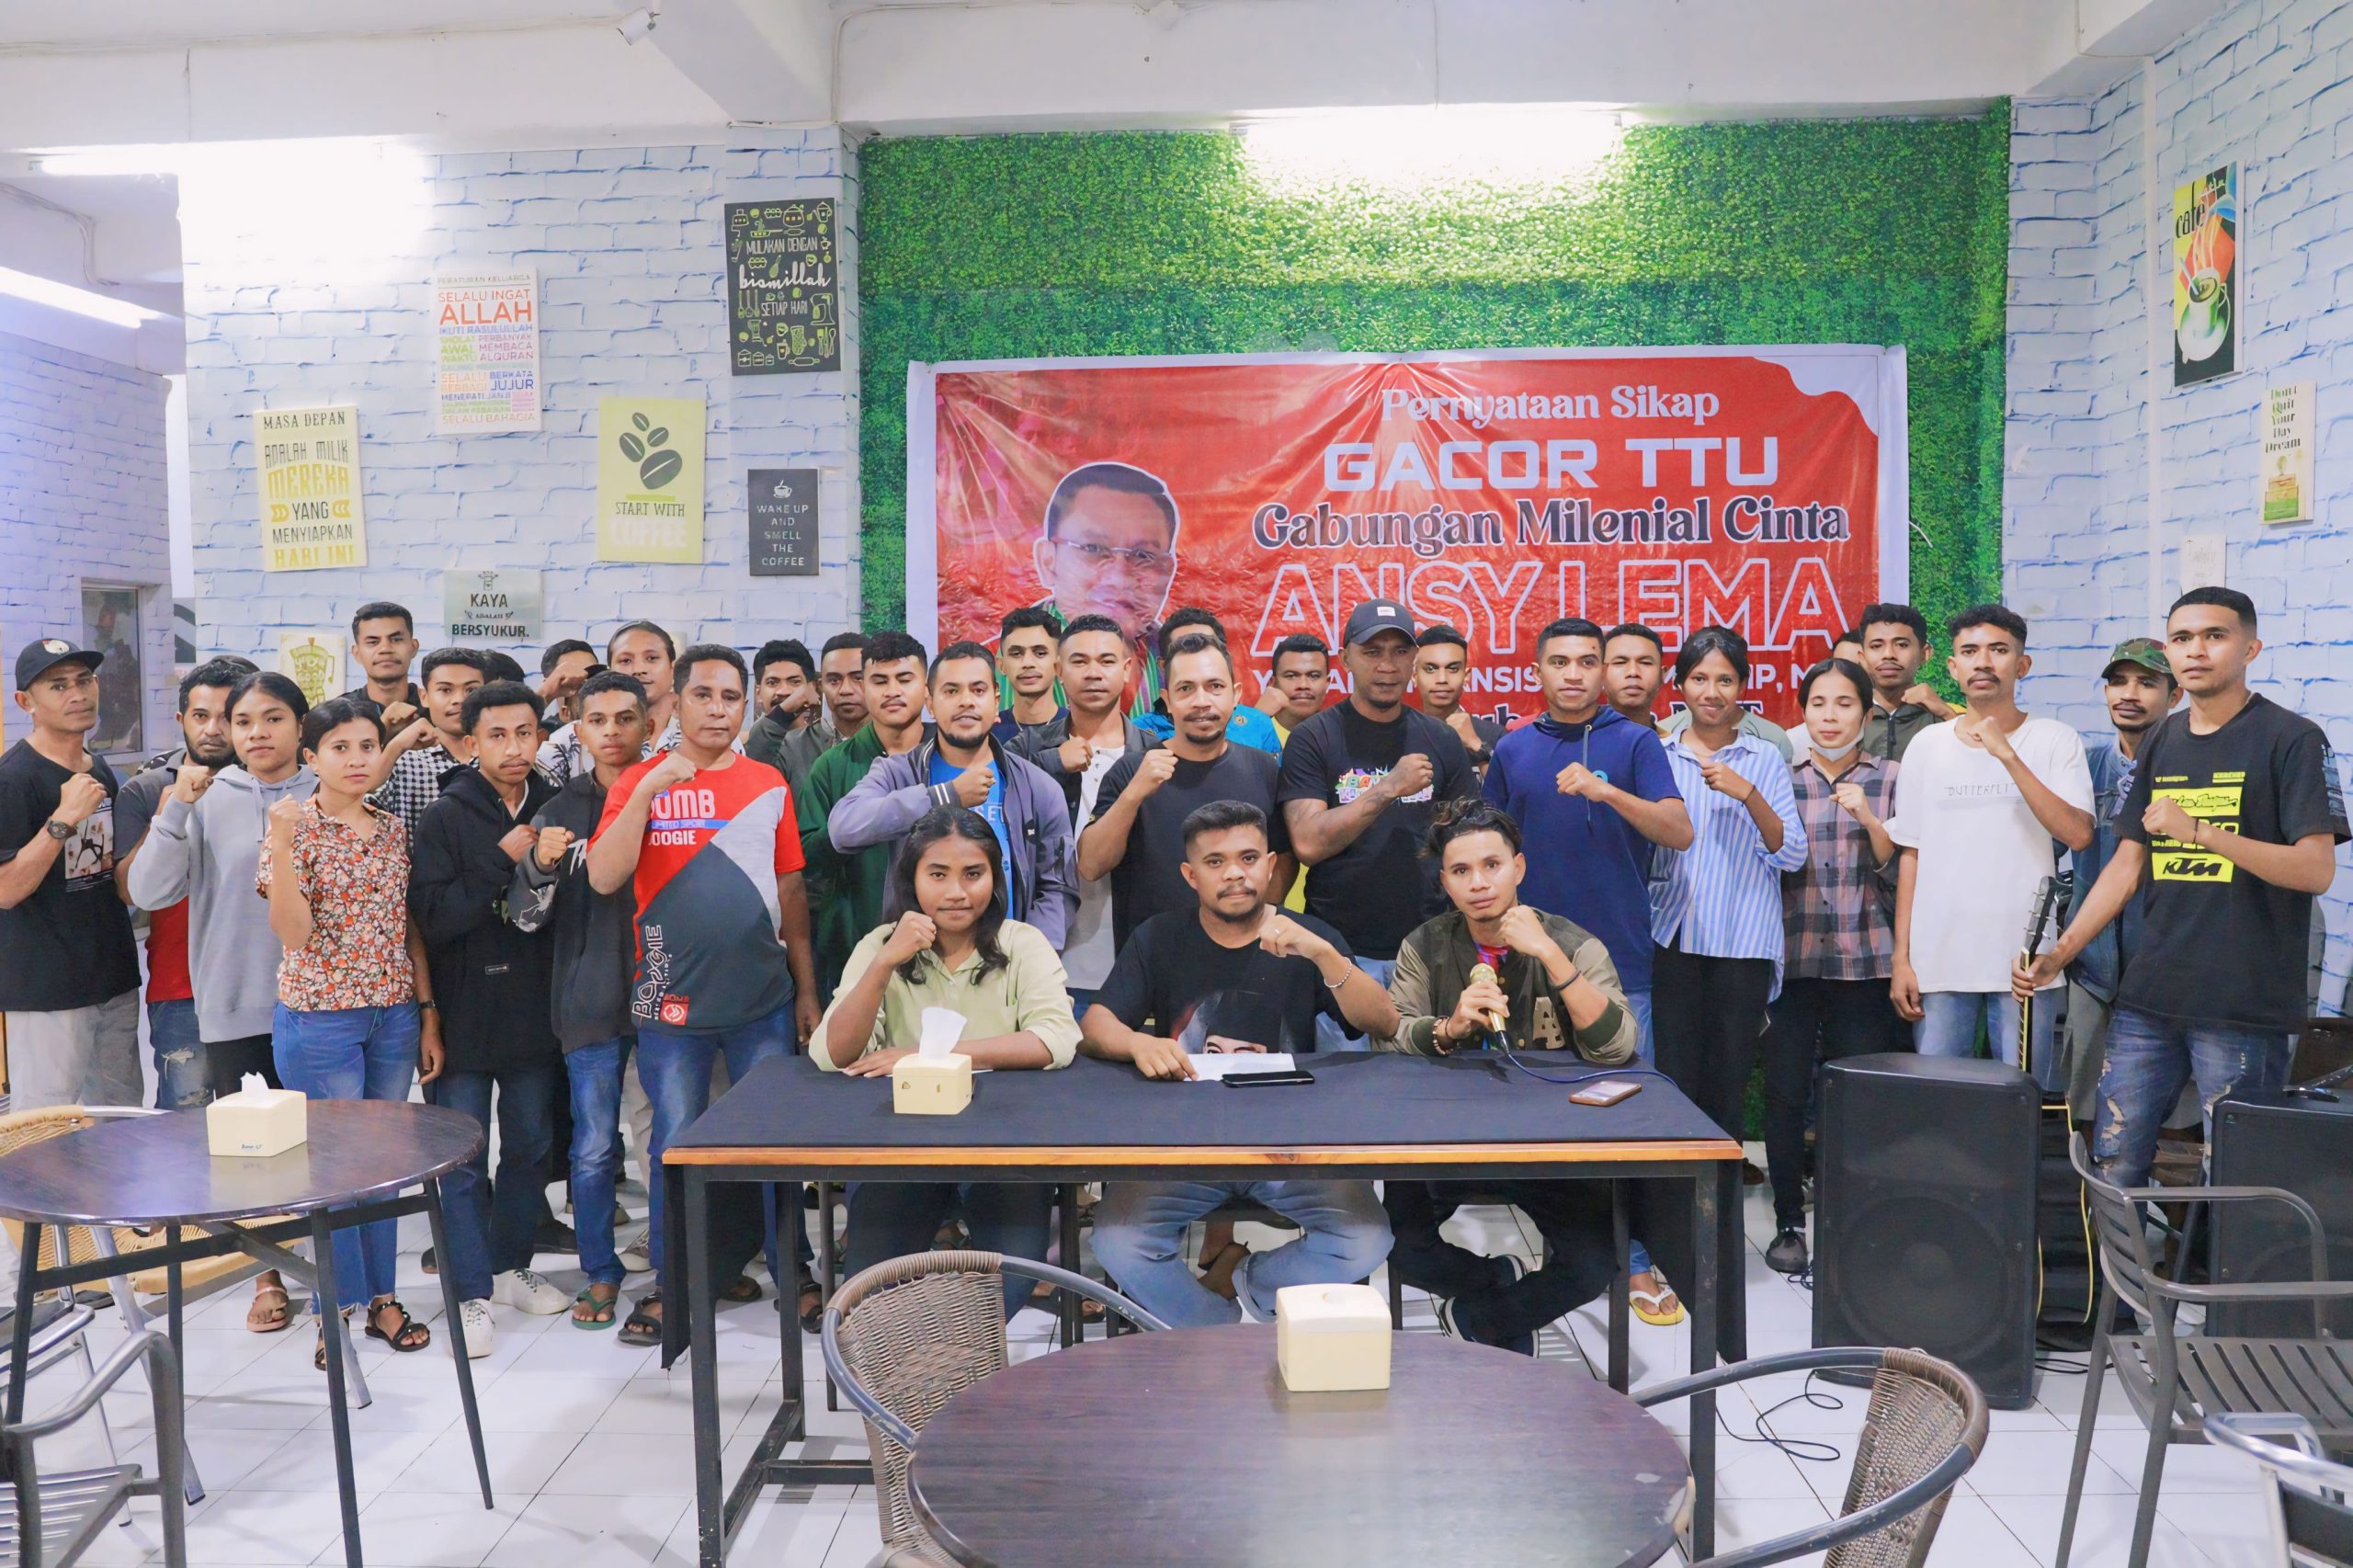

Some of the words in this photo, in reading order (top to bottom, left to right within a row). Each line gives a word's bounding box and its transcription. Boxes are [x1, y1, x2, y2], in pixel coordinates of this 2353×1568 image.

[788, 237, 818, 252] DENGAN
[438, 290, 487, 302] SELALU
[492, 289, 530, 301] INGAT
[440, 301, 532, 325] ALLAH
[761, 301, 788, 316] SETIAP
[790, 301, 808, 314] HARI
[479, 342, 533, 351] MEMBACA
[480, 351, 533, 361] ALQURAN
[490, 379, 534, 391] JUJUR
[1381, 388, 1600, 429] Pernyataan
[1610, 385, 1719, 426] Sikap
[264, 415, 299, 429] MASA
[304, 411, 346, 427] DEPAN
[264, 442, 307, 469] ADALAH
[315, 439, 348, 463] MILIK
[1324, 438, 1599, 492] GACOR
[1625, 437, 1778, 487] TTU
[267, 463, 349, 499] MEREKA
[291, 501, 329, 521] YANG
[616, 502, 649, 516] START
[654, 503, 685, 517] WITH
[756, 505, 790, 514] WAKE
[793, 505, 809, 514] UP
[771, 517, 795, 527] AND
[1253, 502, 1505, 558] Gabungan
[1515, 496, 1712, 545] Milenial
[1722, 494, 1851, 542] Cinta
[272, 524, 353, 544] MENYIAPKAN
[764, 530, 801, 540] SMELL
[772, 543, 793, 553] THE
[275, 546, 319, 568] HARI
[761, 557, 805, 566] COFFEE
[471, 593, 508, 608] KAYA
[1250, 561, 1543, 655] ANSY
[1558, 557, 1851, 653] LEMA
[452, 624, 529, 638] BERSYUKUR.
[2163, 857, 2222, 876] KTM
